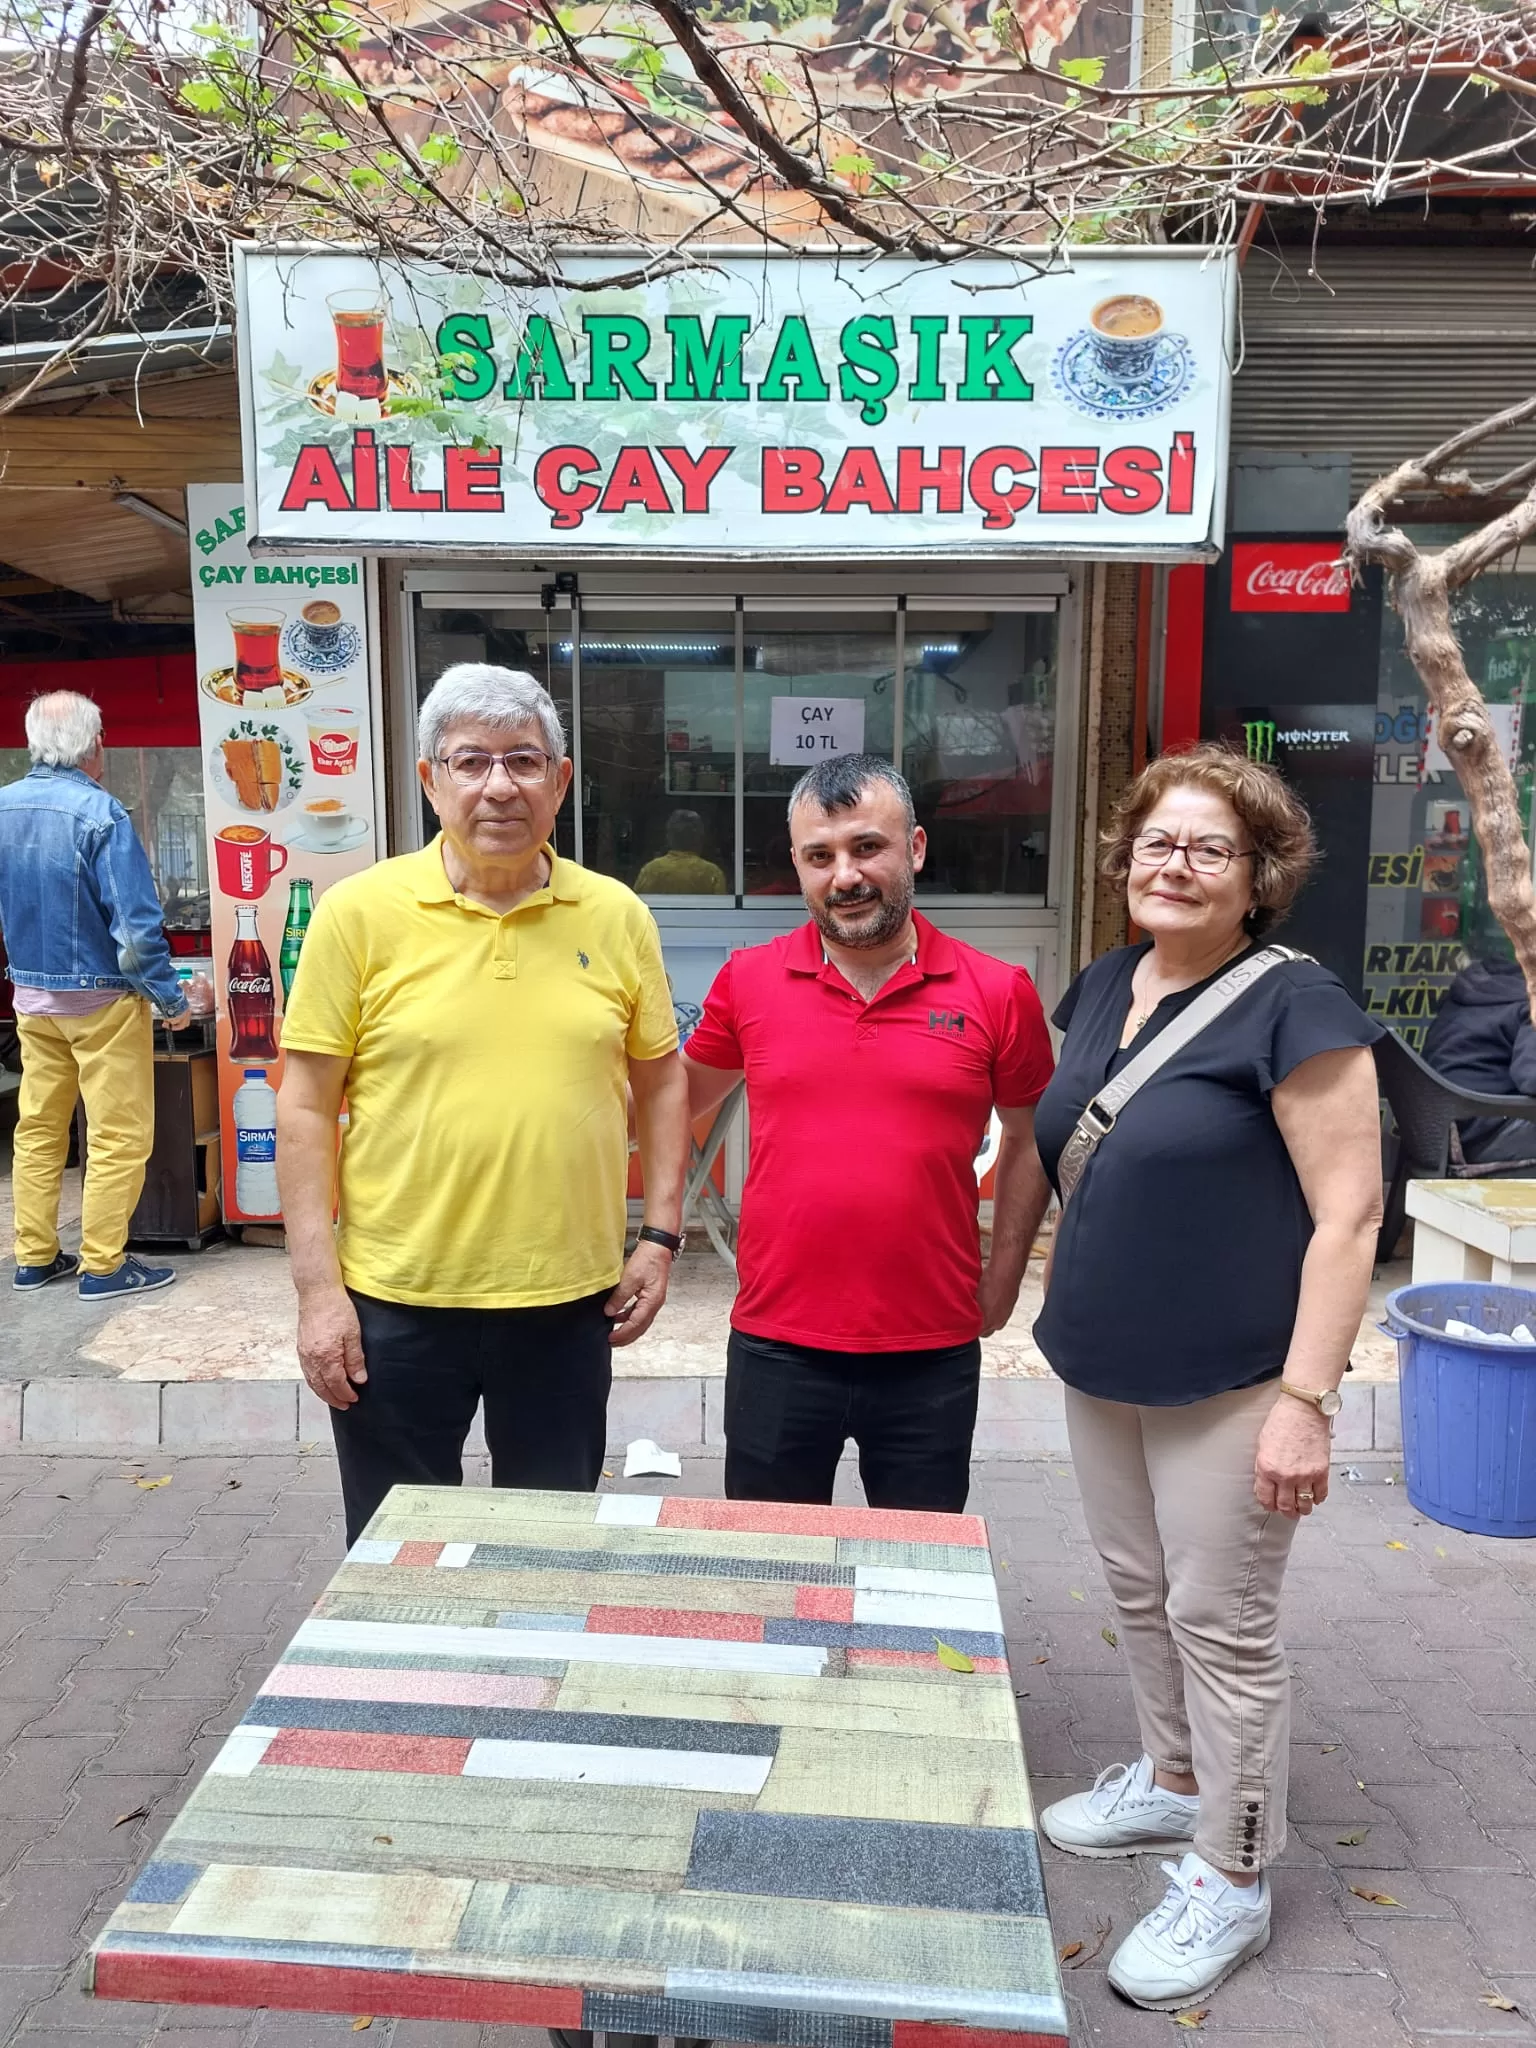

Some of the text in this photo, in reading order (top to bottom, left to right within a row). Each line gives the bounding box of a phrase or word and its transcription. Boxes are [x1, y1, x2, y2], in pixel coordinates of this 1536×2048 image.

[437, 313, 1034, 425] SARMAŞIK
[278, 429, 1196, 531] AİLE ÇAY BAHÇESİ
[199, 563, 358, 588] ÇAY BAHÇESİ
[1247, 561, 1351, 596] Coca-Cola
[801, 706, 833, 725] ÇAY
[796, 734, 838, 749] 10 TL
[1276, 729, 1351, 744] MONSTER
[229, 977, 271, 993] Coca-Cola
[928, 1009, 965, 1032] HH
